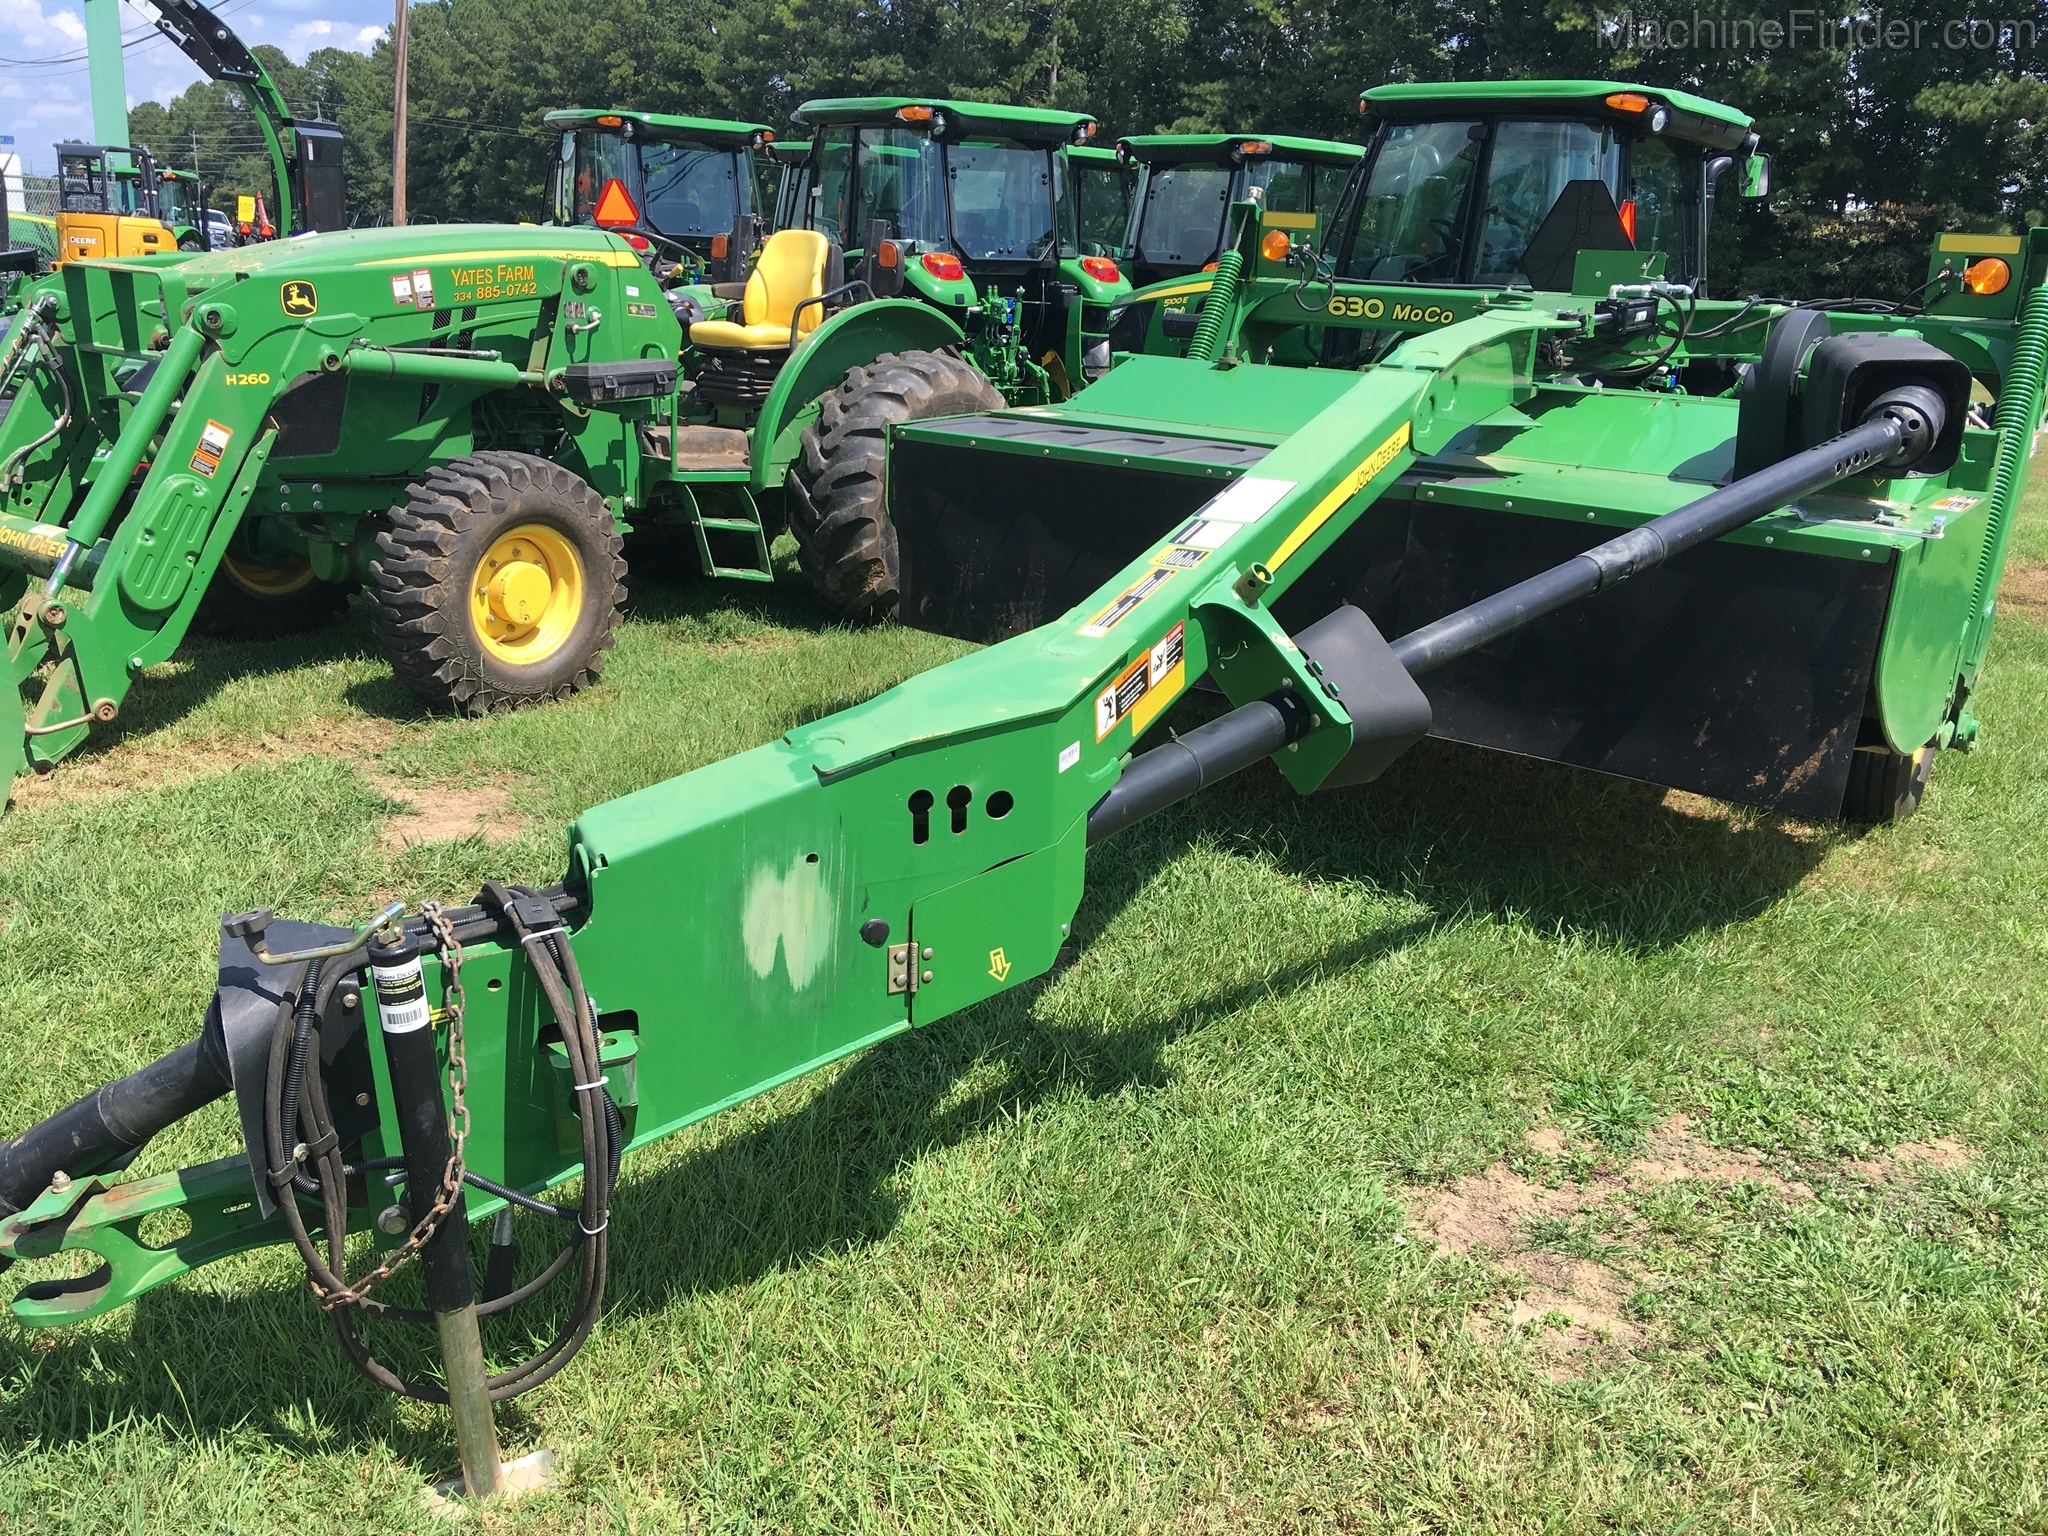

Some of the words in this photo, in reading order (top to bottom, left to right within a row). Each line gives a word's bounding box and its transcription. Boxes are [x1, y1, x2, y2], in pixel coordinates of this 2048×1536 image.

[70, 236, 98, 245] DEERE
[451, 268, 493, 287] YATES
[497, 264, 534, 283] FARM
[454, 291, 472, 302] 334
[476, 282, 537, 300] 885-0742
[1328, 296, 1384, 318] 630
[1392, 304, 1454, 324] MoCo
[226, 373, 270, 386] H260
[29, 533, 70, 558] DEER
